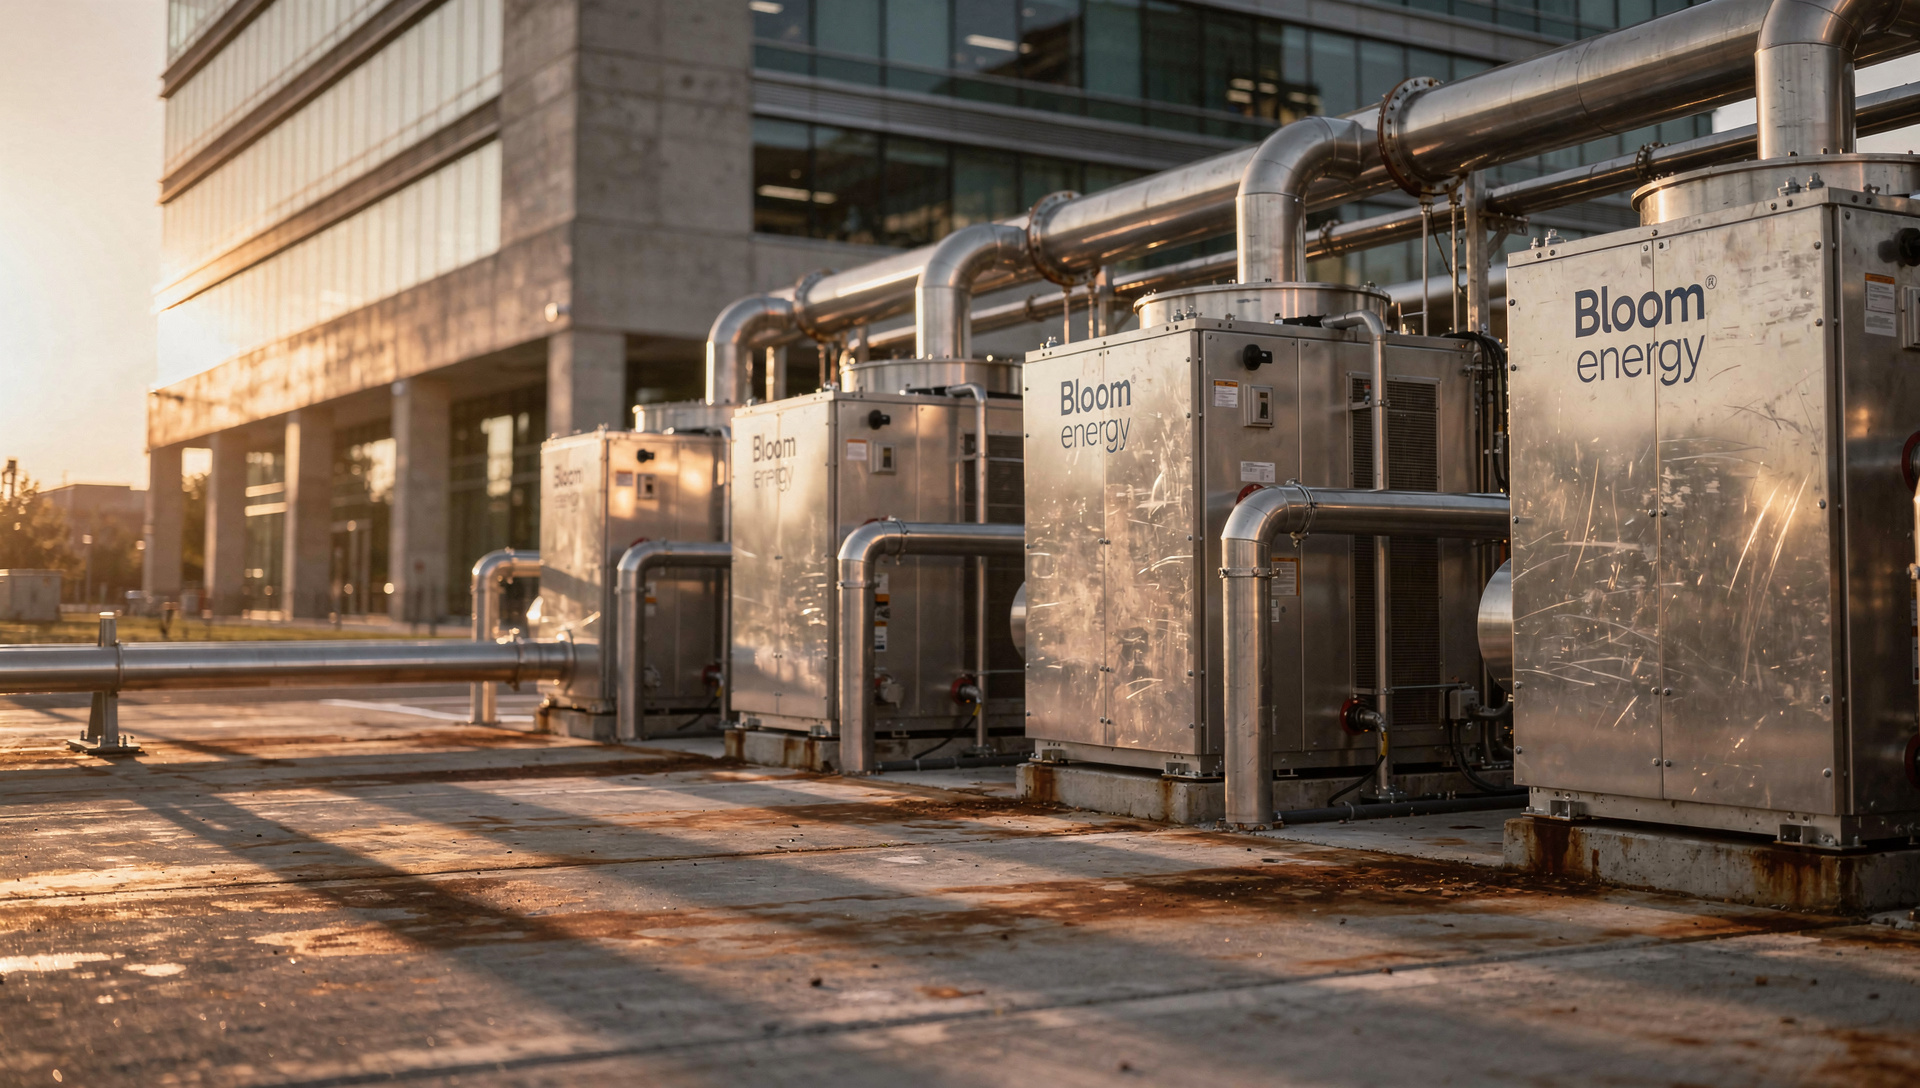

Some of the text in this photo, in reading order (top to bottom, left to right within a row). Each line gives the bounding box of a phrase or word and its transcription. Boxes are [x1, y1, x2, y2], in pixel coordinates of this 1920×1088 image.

[1576, 334, 1706, 386] energy
[1061, 378, 1131, 416] Bloom
[753, 433, 796, 463] Bloom
[1061, 416, 1131, 454] energy
